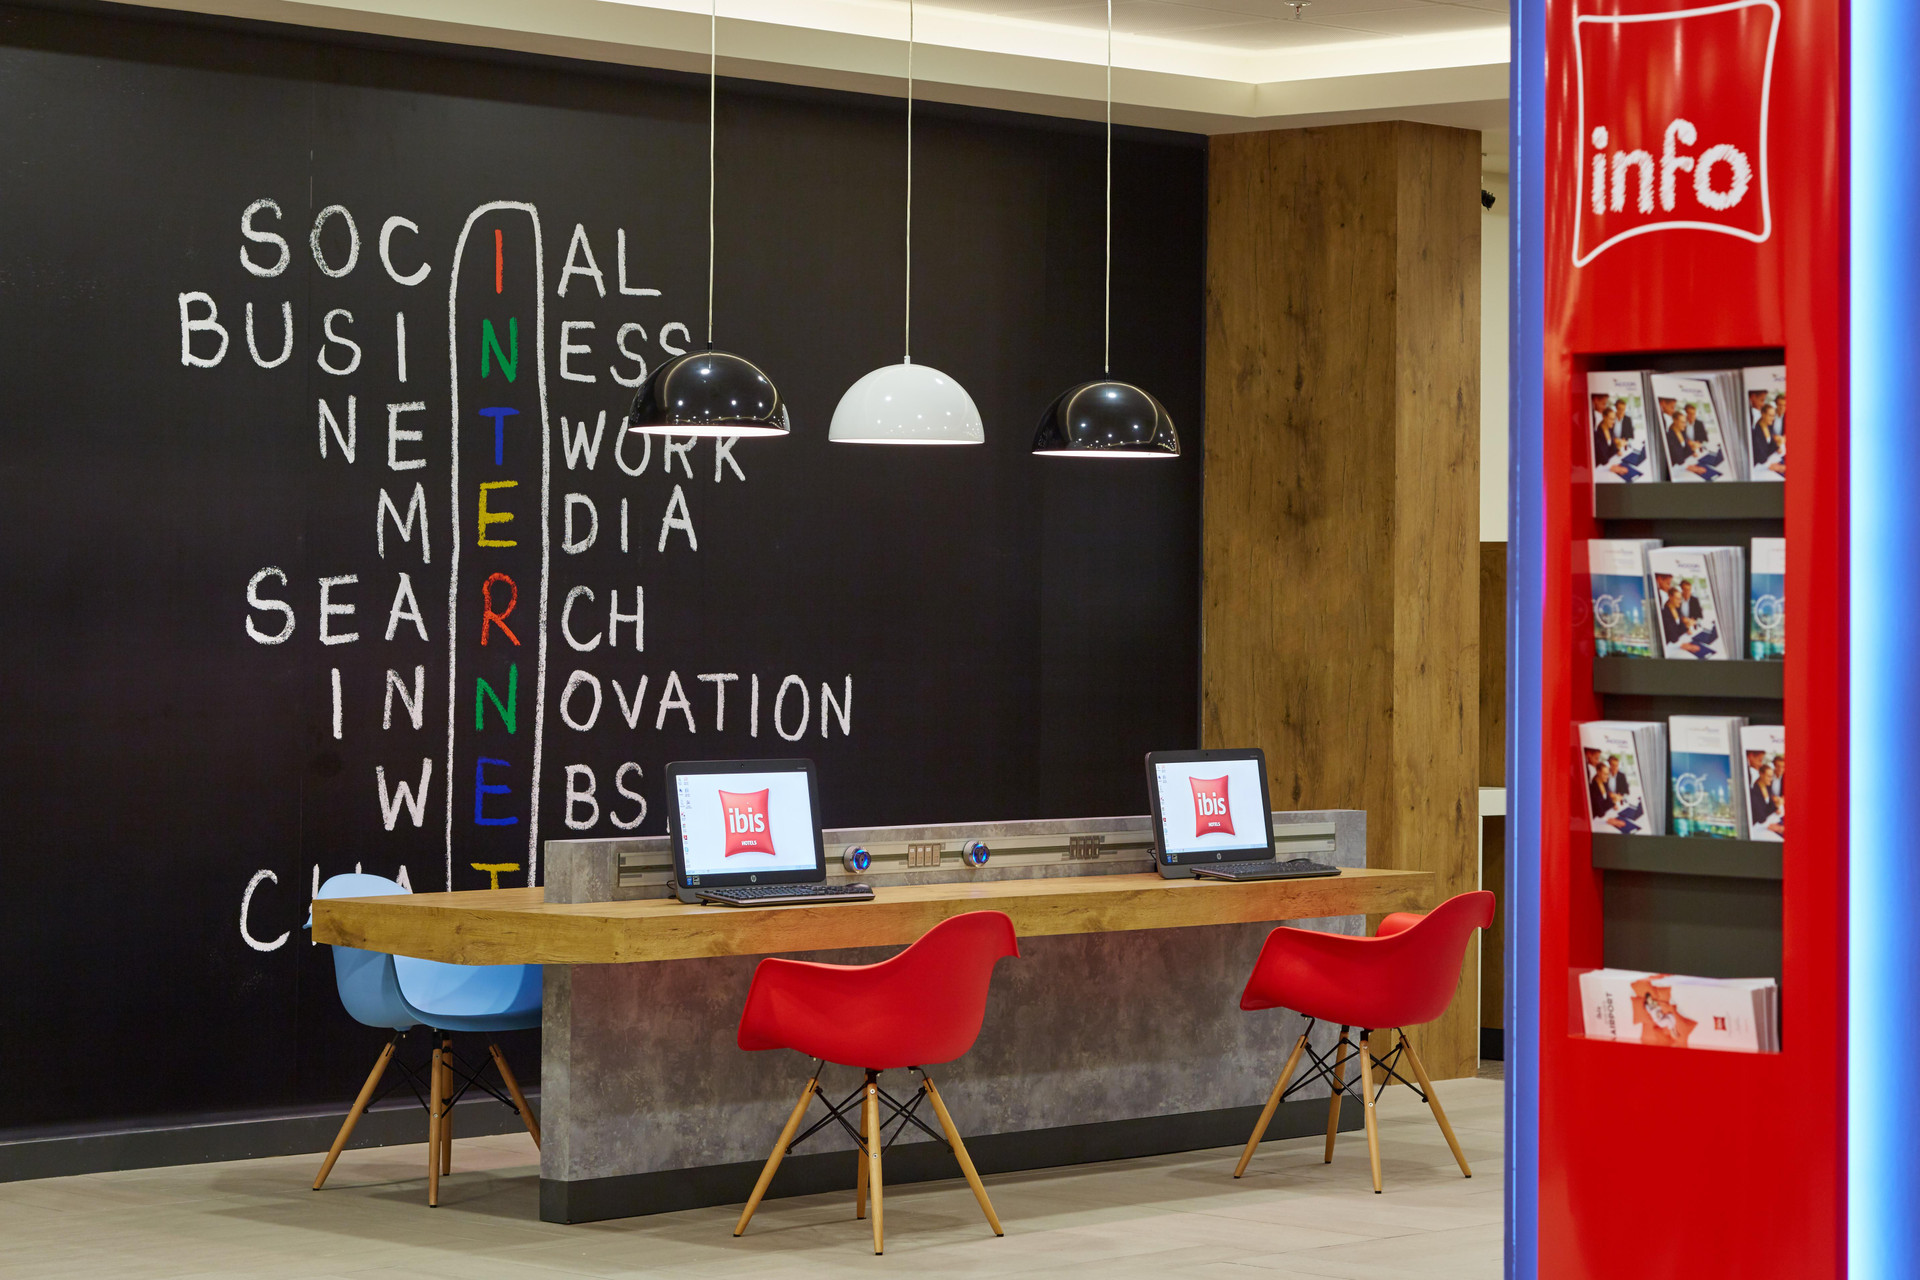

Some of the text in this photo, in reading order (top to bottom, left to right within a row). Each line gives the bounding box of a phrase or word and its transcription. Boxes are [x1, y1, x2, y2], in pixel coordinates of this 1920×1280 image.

[1591, 118, 1753, 215] info
[1197, 792, 1227, 816] ibis
[728, 807, 765, 834] ibis
